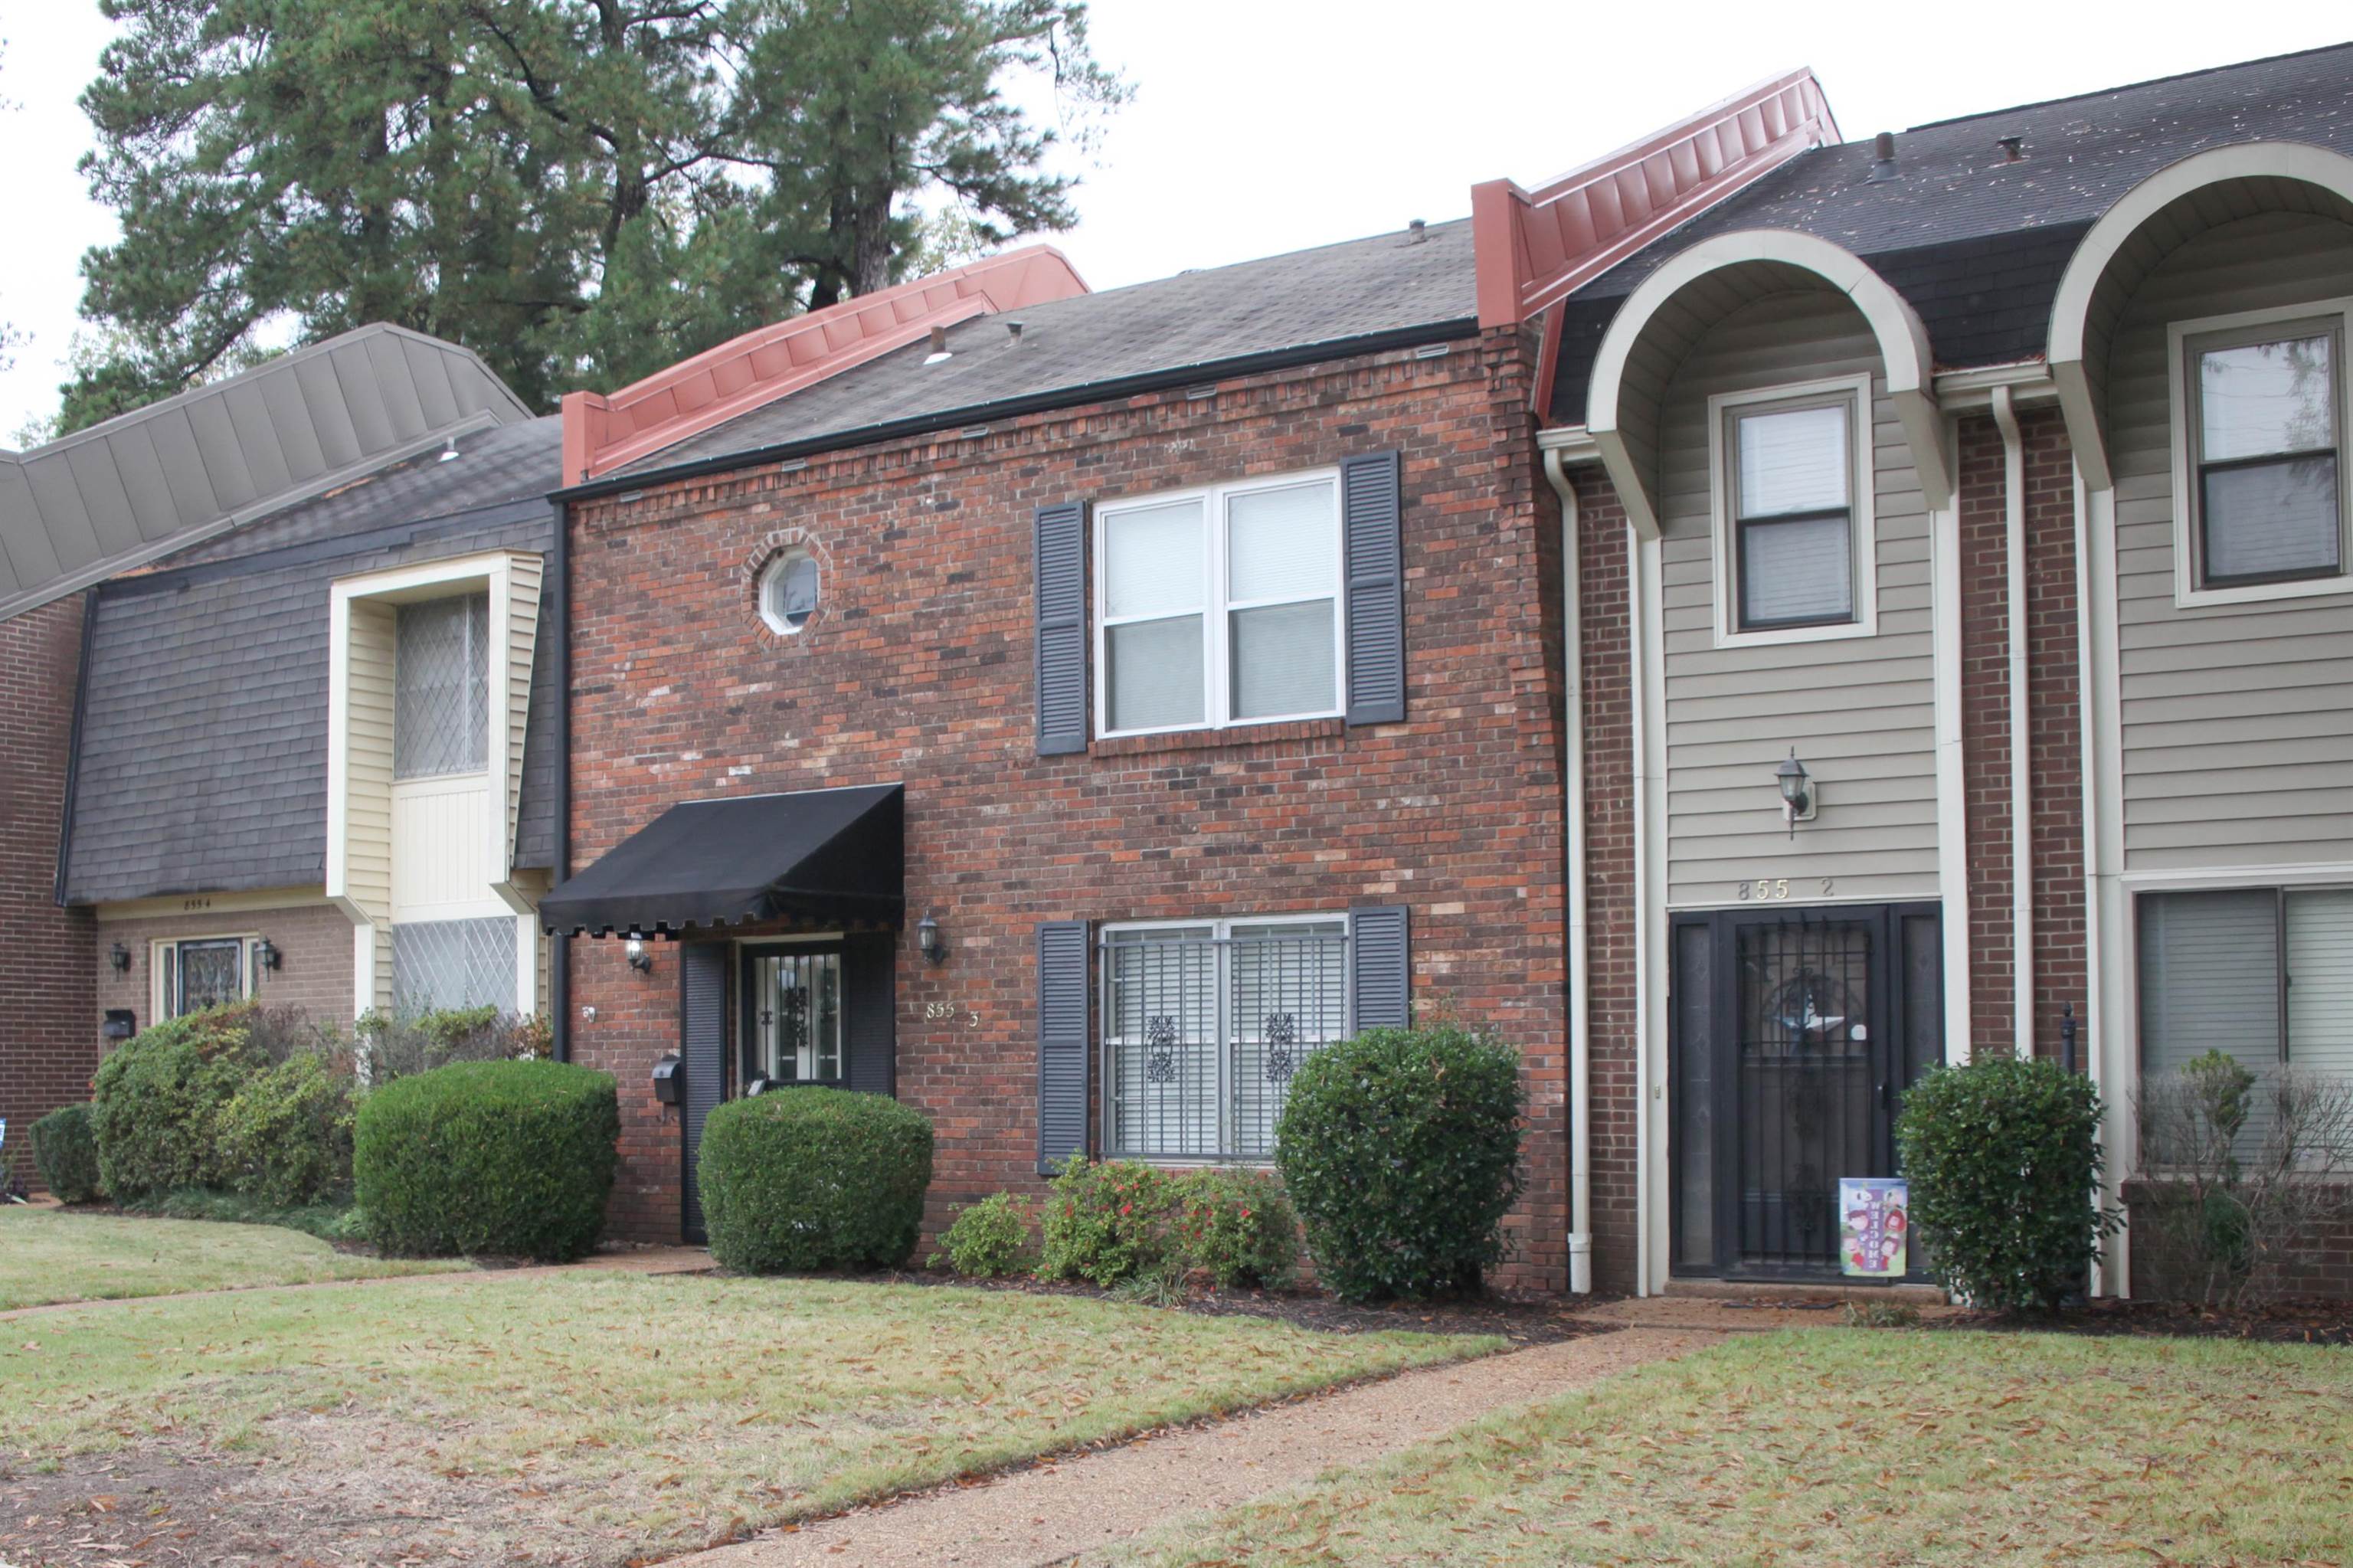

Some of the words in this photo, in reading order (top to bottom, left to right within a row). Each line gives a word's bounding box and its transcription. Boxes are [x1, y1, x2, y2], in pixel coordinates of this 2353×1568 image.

[1738, 879, 1788, 900] 855
[1821, 877, 1834, 896] 2
[927, 1003, 954, 1018] 855
